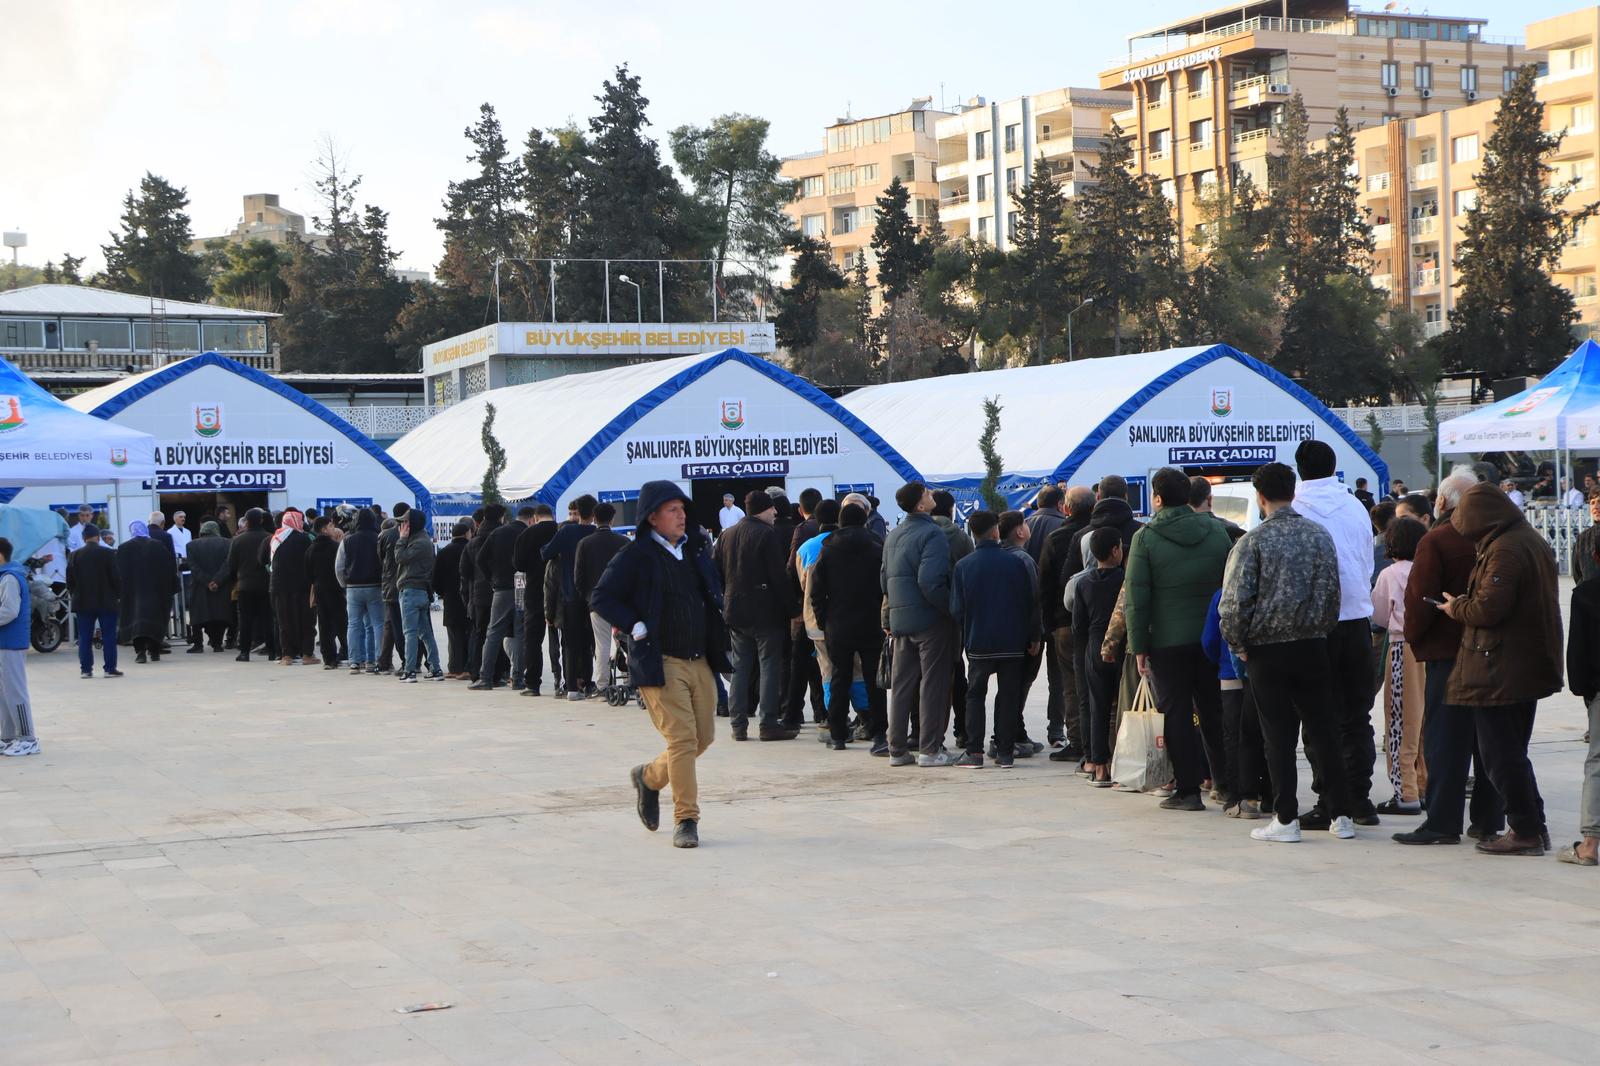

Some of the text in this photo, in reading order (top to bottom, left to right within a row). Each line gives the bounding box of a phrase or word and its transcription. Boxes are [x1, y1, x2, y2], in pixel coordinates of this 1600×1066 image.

[526, 329, 641, 349] BÜYÜKŞEHİR
[645, 328, 745, 346] BELEDİYESİ
[1129, 421, 1315, 446] ŞANLIURFA BÜYÜKŞEHİR BELEDİYESİ
[34, 451, 93, 461] BELEDİYESİ
[166, 442, 254, 470] BÜYÜKŞEHİR
[258, 442, 333, 464] BELEDİYESİ
[626, 432, 838, 463] ŞANLIURFA BÜYÜKŞEHİR BELEDİYESİ
[1171, 448, 1274, 462] İFTAR ÇADIRI
[686, 461, 784, 476] İFTAR ÇADIRI
[147, 473, 282, 488] FTAR ÇADIRI
